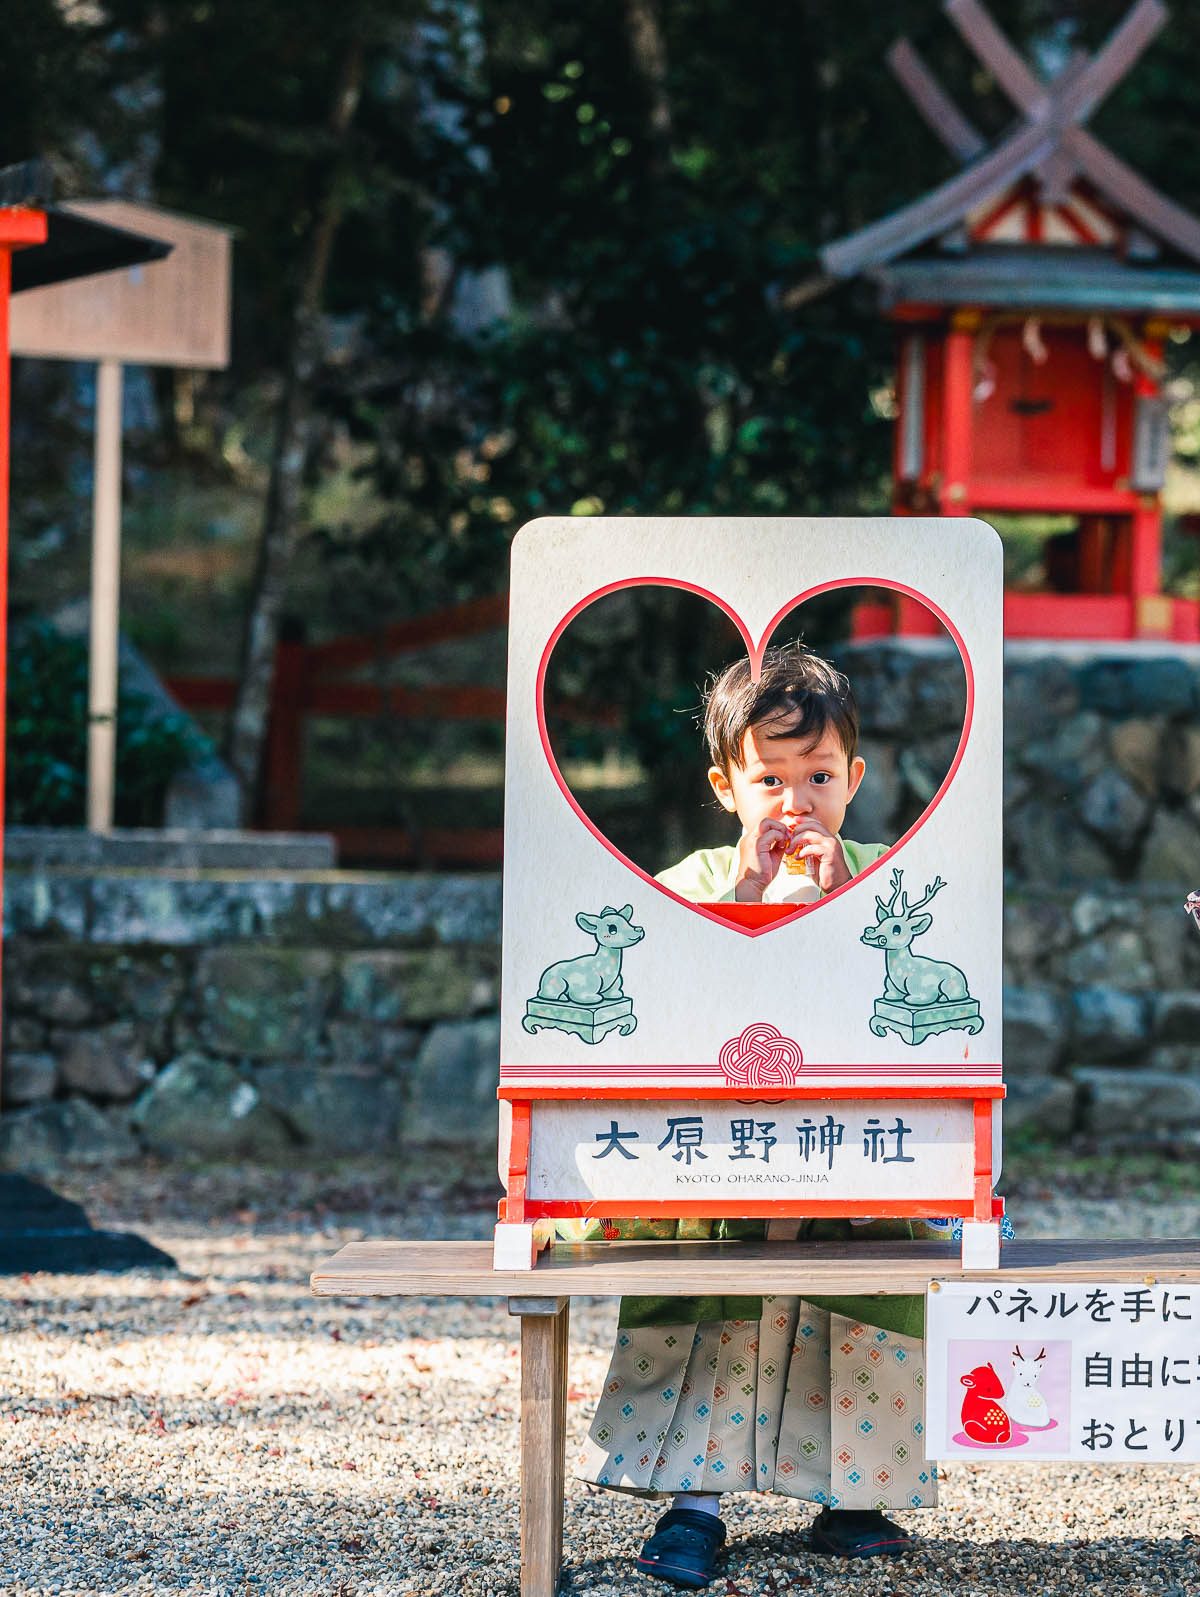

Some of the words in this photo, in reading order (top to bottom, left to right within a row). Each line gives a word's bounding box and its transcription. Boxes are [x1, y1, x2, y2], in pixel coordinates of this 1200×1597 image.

[592, 1116, 915, 1170] 大原野神社
[674, 1173, 722, 1185] KYOTO
[726, 1173, 830, 1185] OHARANO-JINJA
